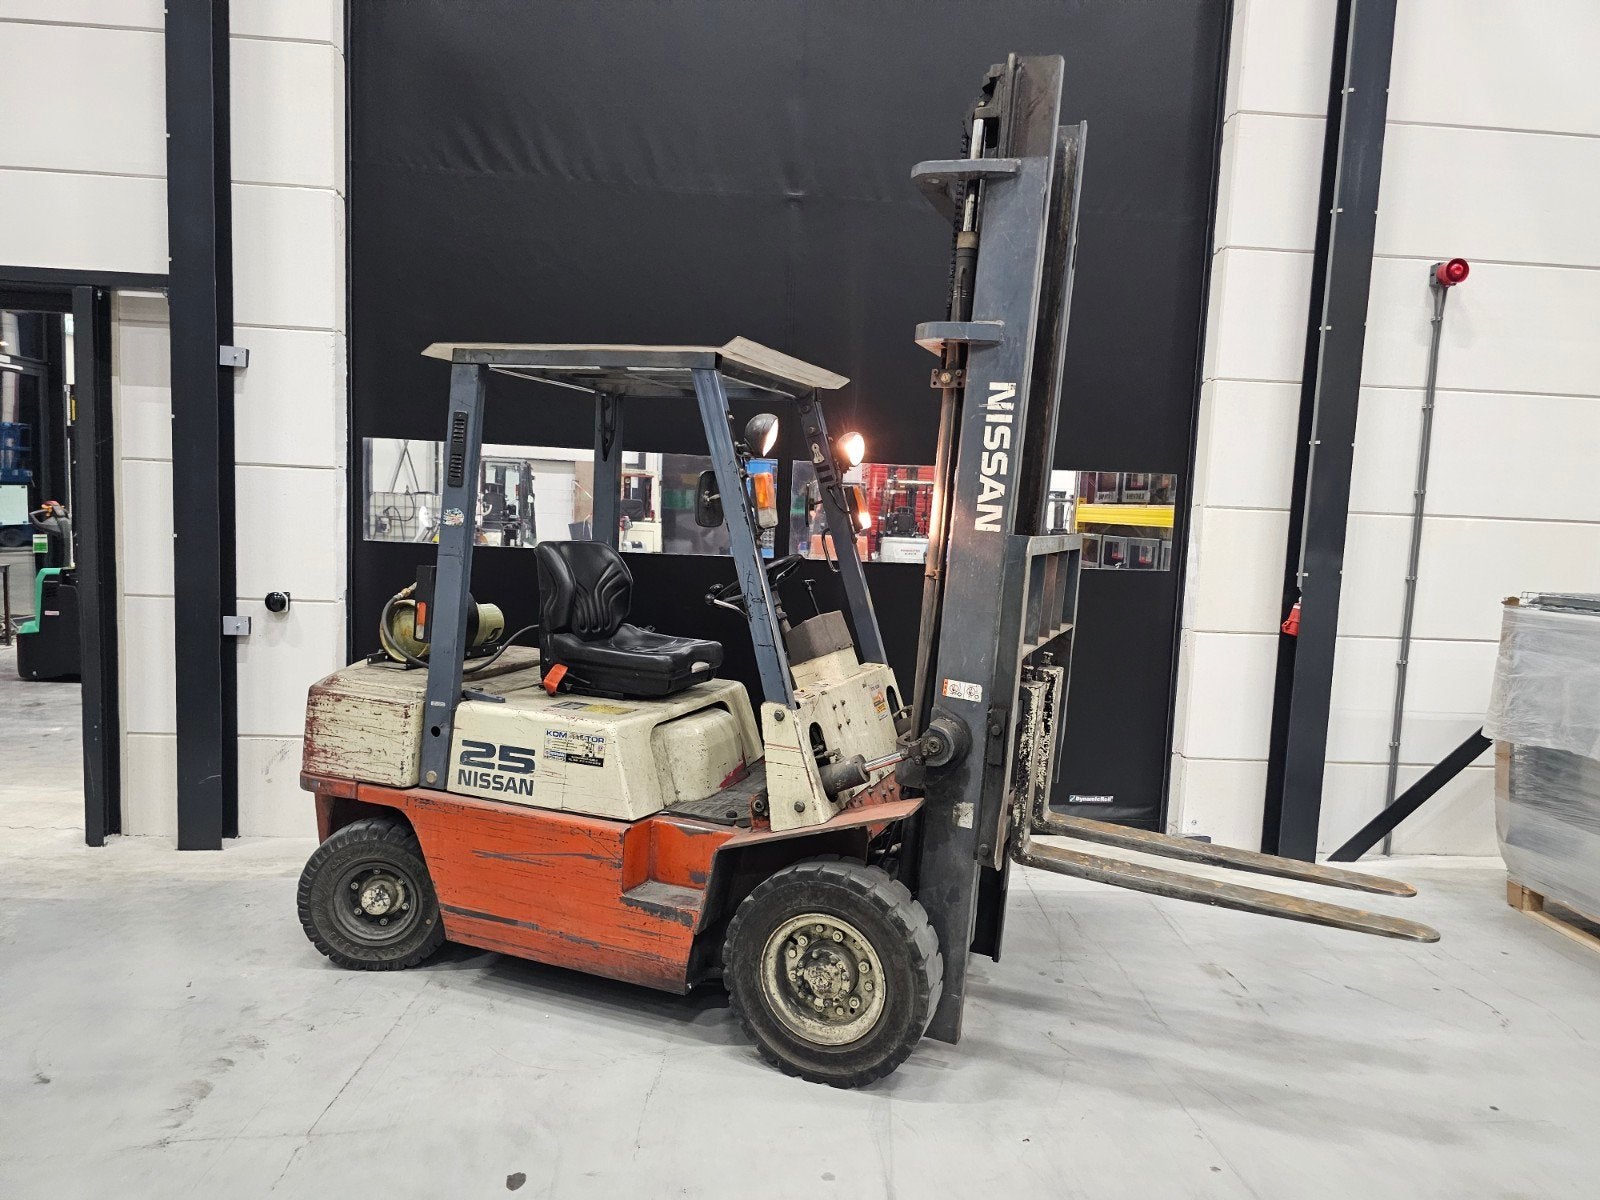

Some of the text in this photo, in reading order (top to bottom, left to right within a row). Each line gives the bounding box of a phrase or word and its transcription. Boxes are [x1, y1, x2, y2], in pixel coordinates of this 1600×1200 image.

[974, 382, 1016, 532] NISSAN
[460, 740, 536, 774] 25
[457, 769, 534, 796] NISSAN
